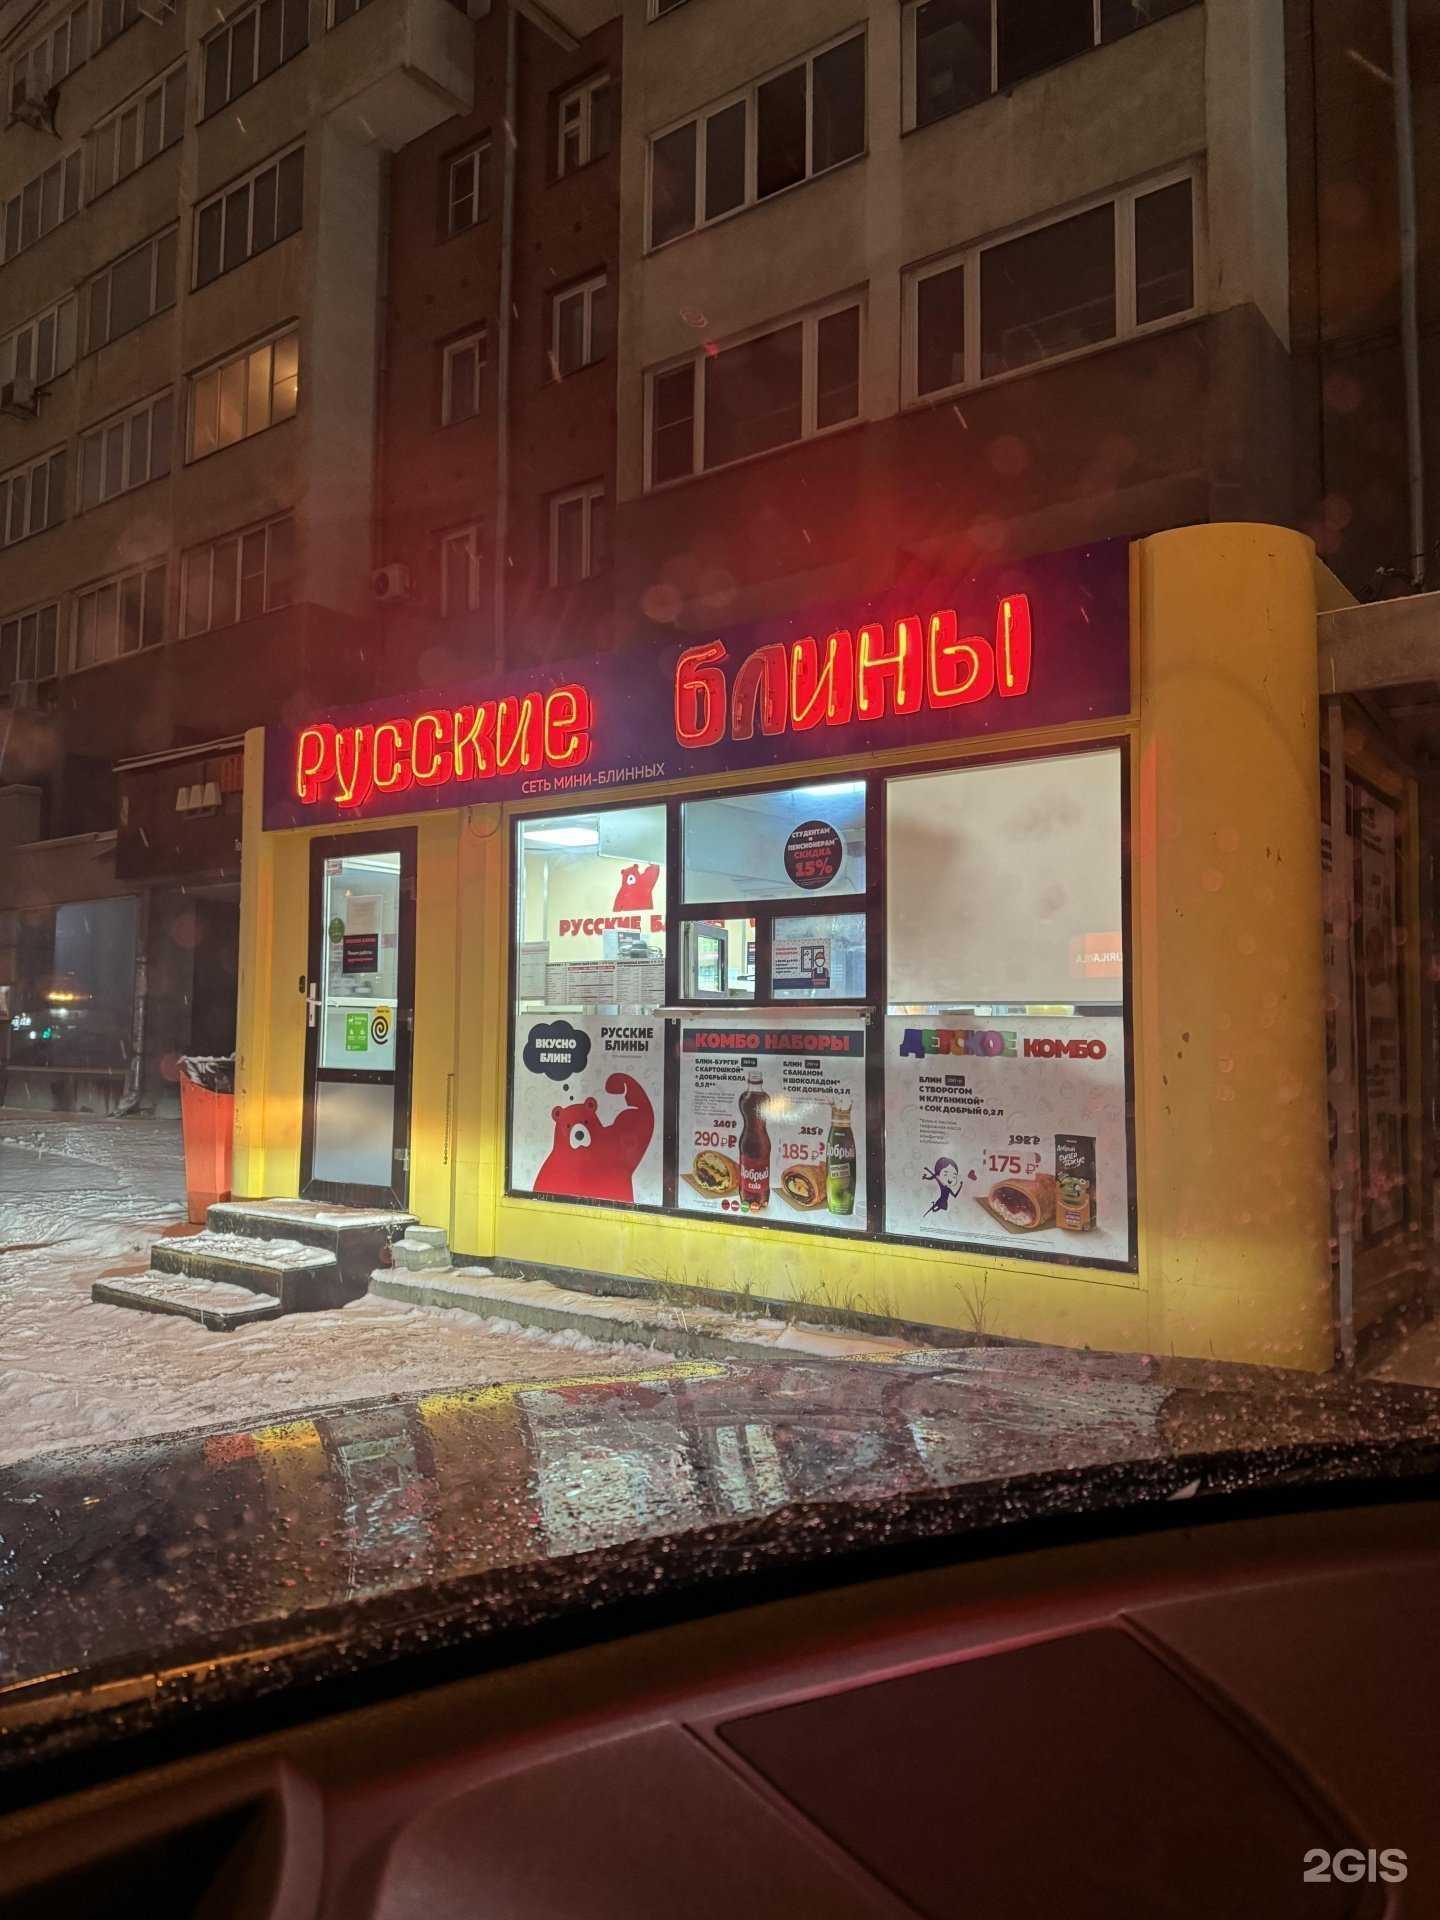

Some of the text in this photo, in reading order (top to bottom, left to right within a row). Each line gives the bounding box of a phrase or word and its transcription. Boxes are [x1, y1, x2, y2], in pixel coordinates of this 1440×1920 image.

[521, 763, 665, 794] СЕТЬ МИНИ-БЛИННЫХ
[794, 847, 832, 859] СКИДКА
[601, 1027, 654, 1039] РУССКИЕ
[535, 1038, 577, 1049] ВКУСНО
[605, 1040, 649, 1052] БЛИНЫ
[695, 1032, 850, 1051] КОМБО НАБОРЫ
[1023, 1037, 1107, 1060] КОМБО
[539, 1052, 572, 1064] БЛИН!
[919, 1076, 942, 1084] БЛИН
[925, 1086, 973, 1095] ТВОРОГОМ
[943, 1106, 982, 1115] ДОБРЫЙ
[782, 1143, 809, 1160] 185
[988, 1154, 1021, 1174] 175
